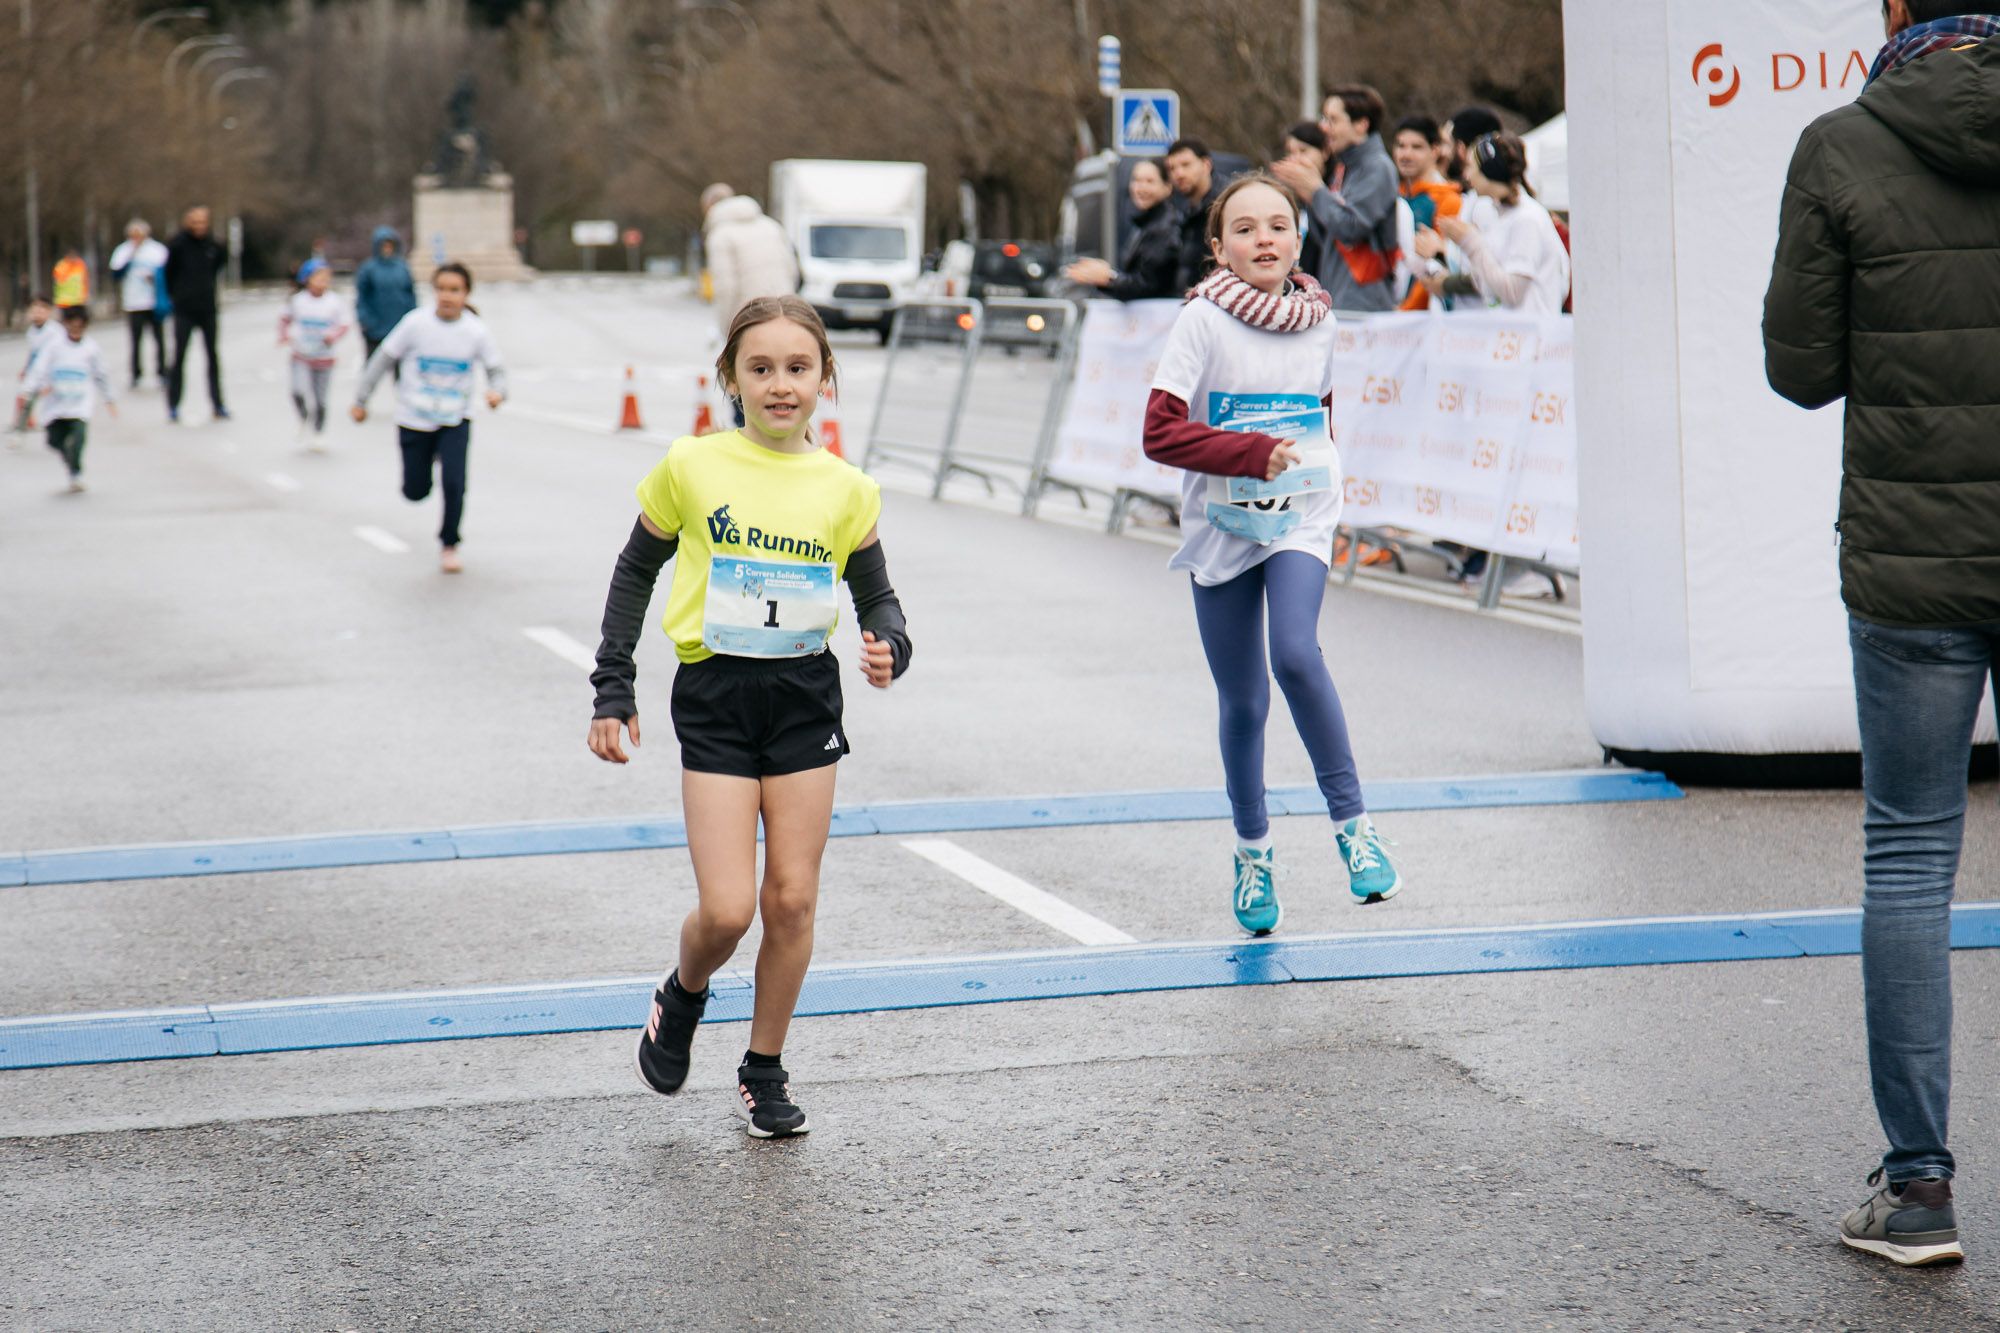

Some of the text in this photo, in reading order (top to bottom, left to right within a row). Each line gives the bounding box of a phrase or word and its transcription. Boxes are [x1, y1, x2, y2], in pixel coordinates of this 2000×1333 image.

[1772, 49, 1868, 90] DIA
[707, 516, 740, 545] VG
[746, 567, 774, 578] Carrera
[777, 570, 807, 581] Solidaria
[763, 600, 780, 628] 1
